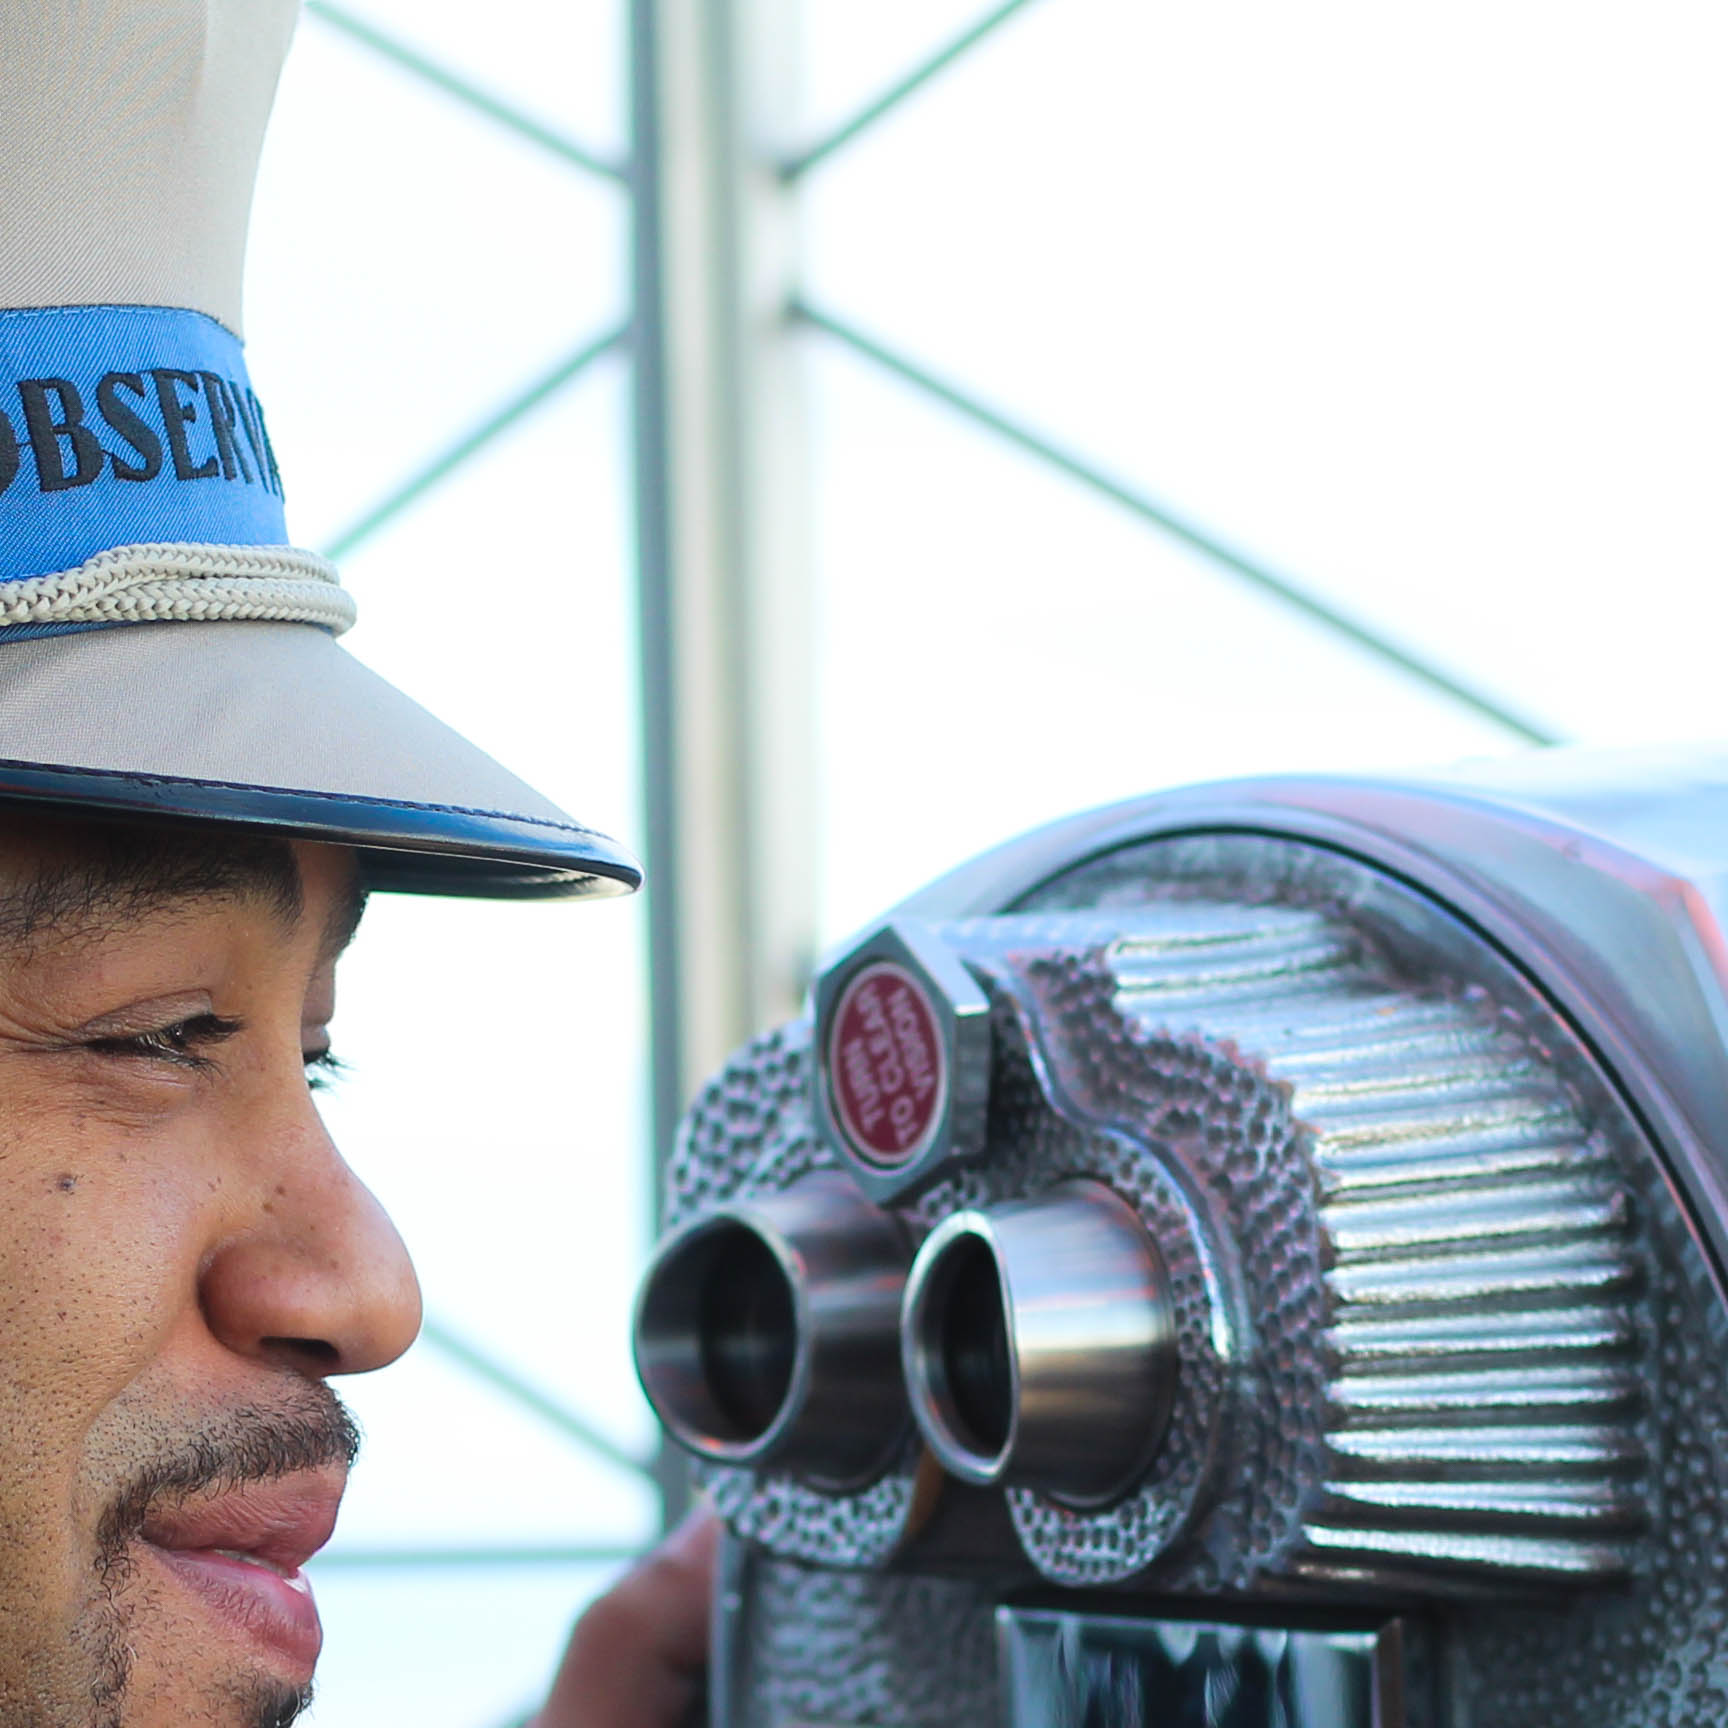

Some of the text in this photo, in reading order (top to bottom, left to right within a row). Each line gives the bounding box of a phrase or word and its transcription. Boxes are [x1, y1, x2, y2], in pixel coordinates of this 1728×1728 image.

[845, 1039, 884, 1132] TURN
[857, 982, 919, 1146] TO CLEAR
[887, 987, 934, 1098] VISION
